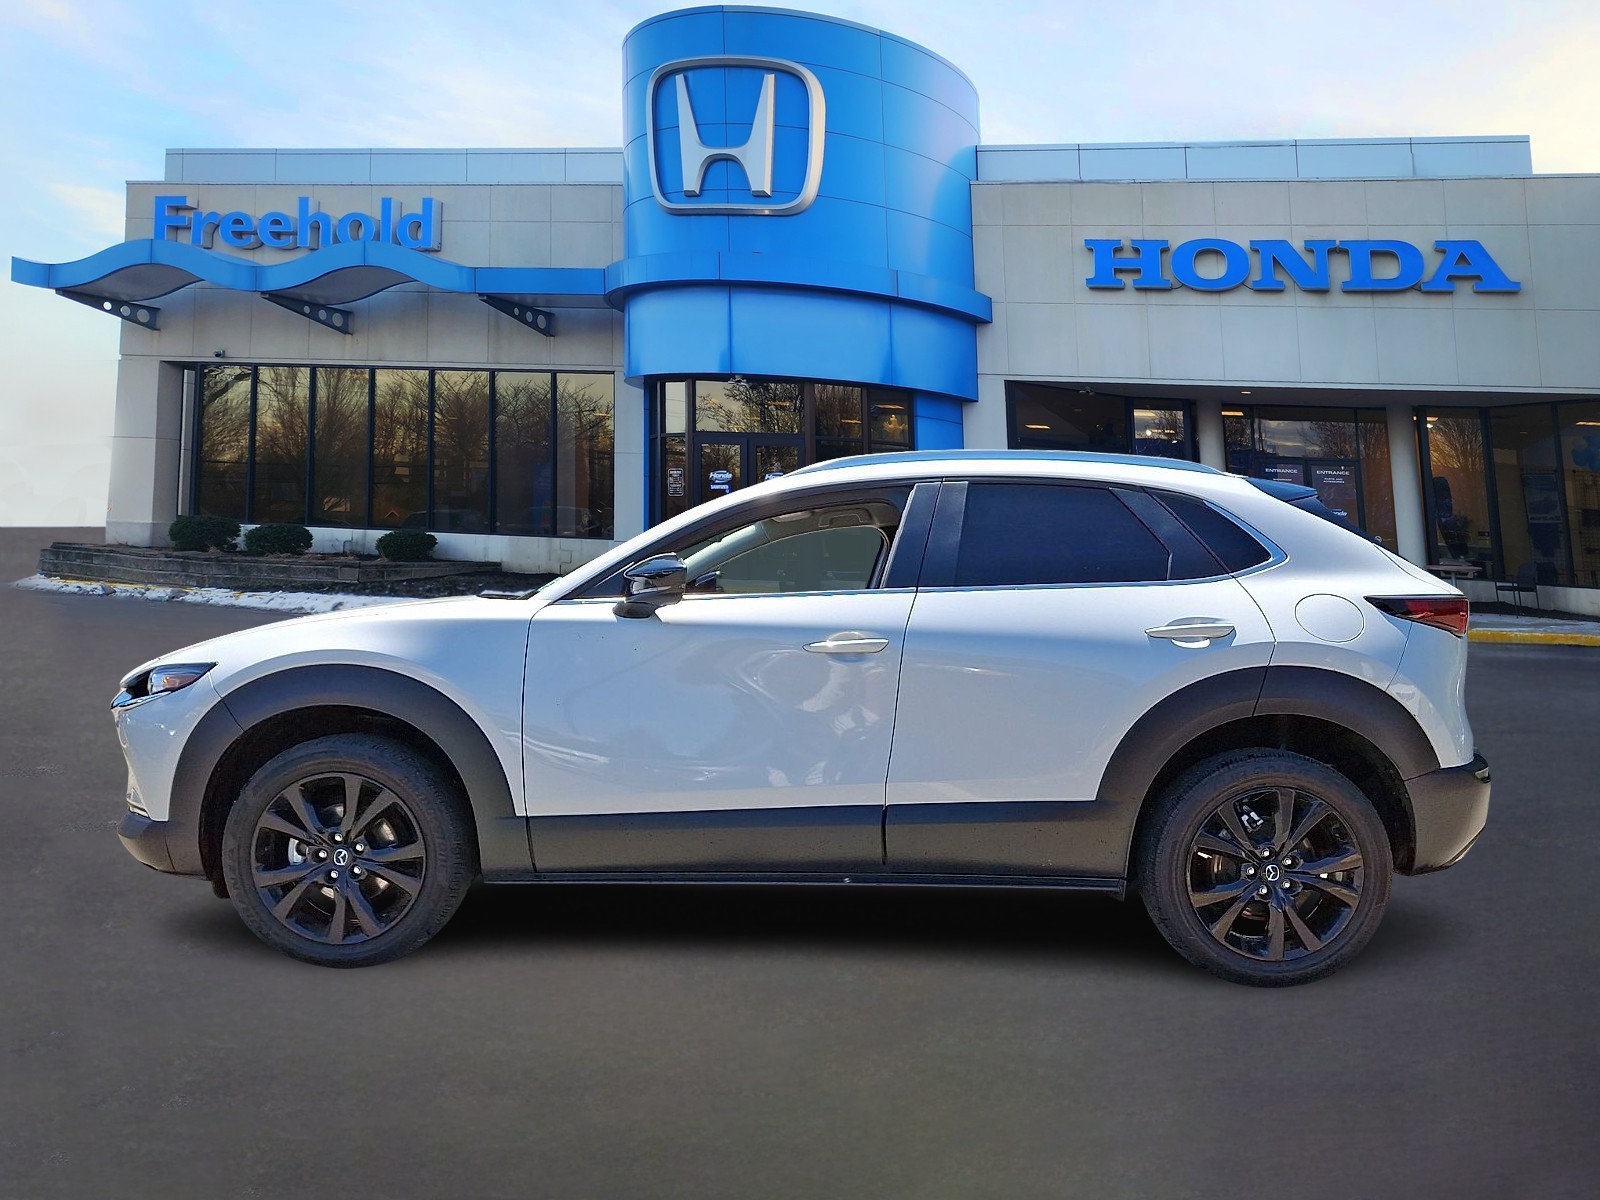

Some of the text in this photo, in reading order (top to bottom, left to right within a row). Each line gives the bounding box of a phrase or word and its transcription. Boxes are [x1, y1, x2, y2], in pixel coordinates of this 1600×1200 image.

[154, 195, 437, 250] Freehold
[1084, 238, 1521, 292] HONDA
[708, 472, 733, 480] Honda
